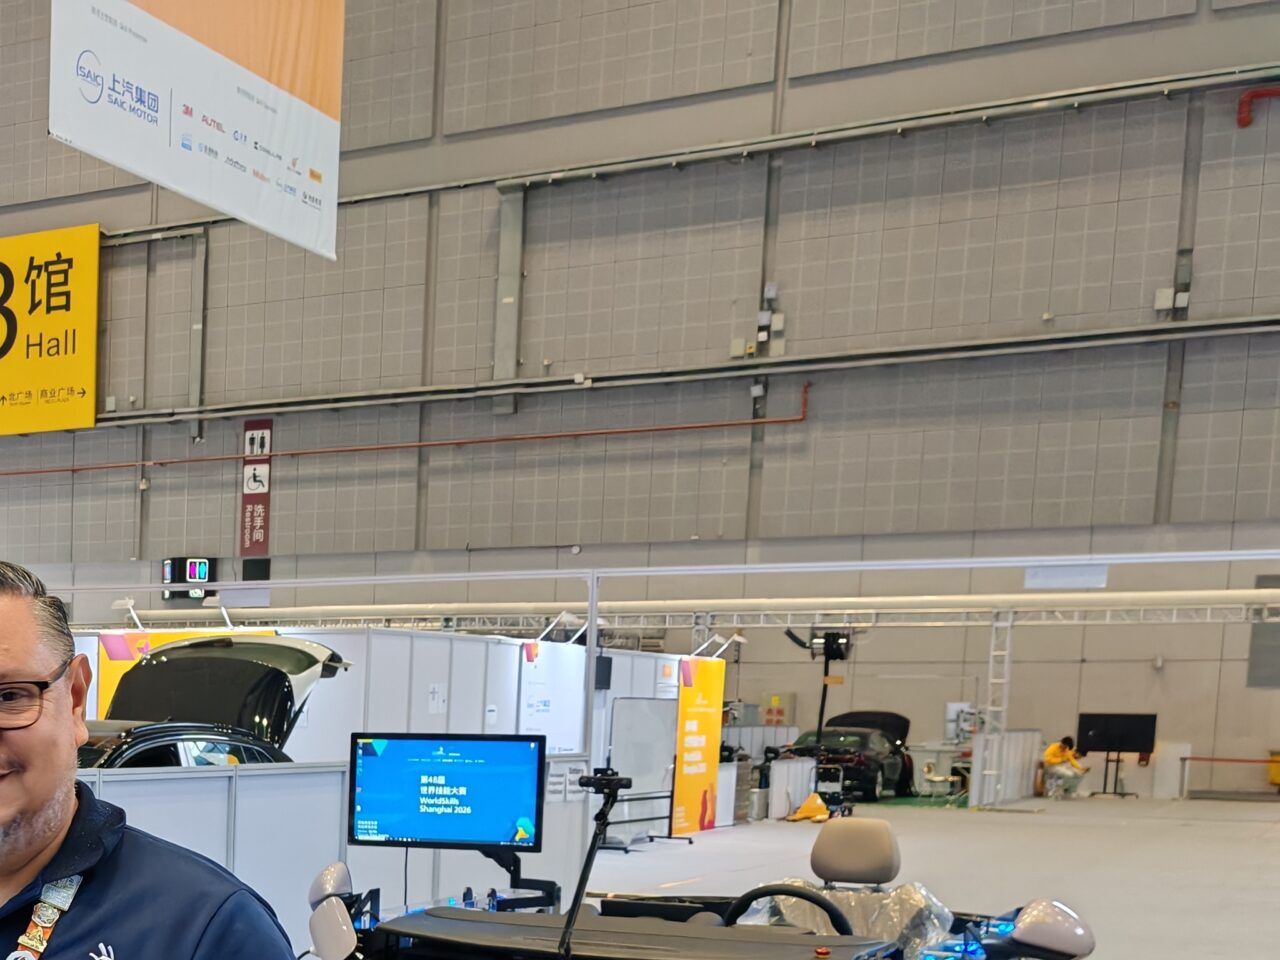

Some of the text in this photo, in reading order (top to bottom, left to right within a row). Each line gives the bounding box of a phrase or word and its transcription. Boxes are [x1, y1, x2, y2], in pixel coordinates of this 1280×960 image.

[79, 66, 102, 86] SAIC
[108, 73, 159, 113] 上汽集团
[107, 93, 159, 126] SAIC MOTOR
[24, 251, 74, 315] 馆
[25, 328, 77, 359] Hall
[244, 504, 253, 548] Restroom
[253, 503, 265, 543] 洗手间
[419, 804, 453, 815] Shanghai
